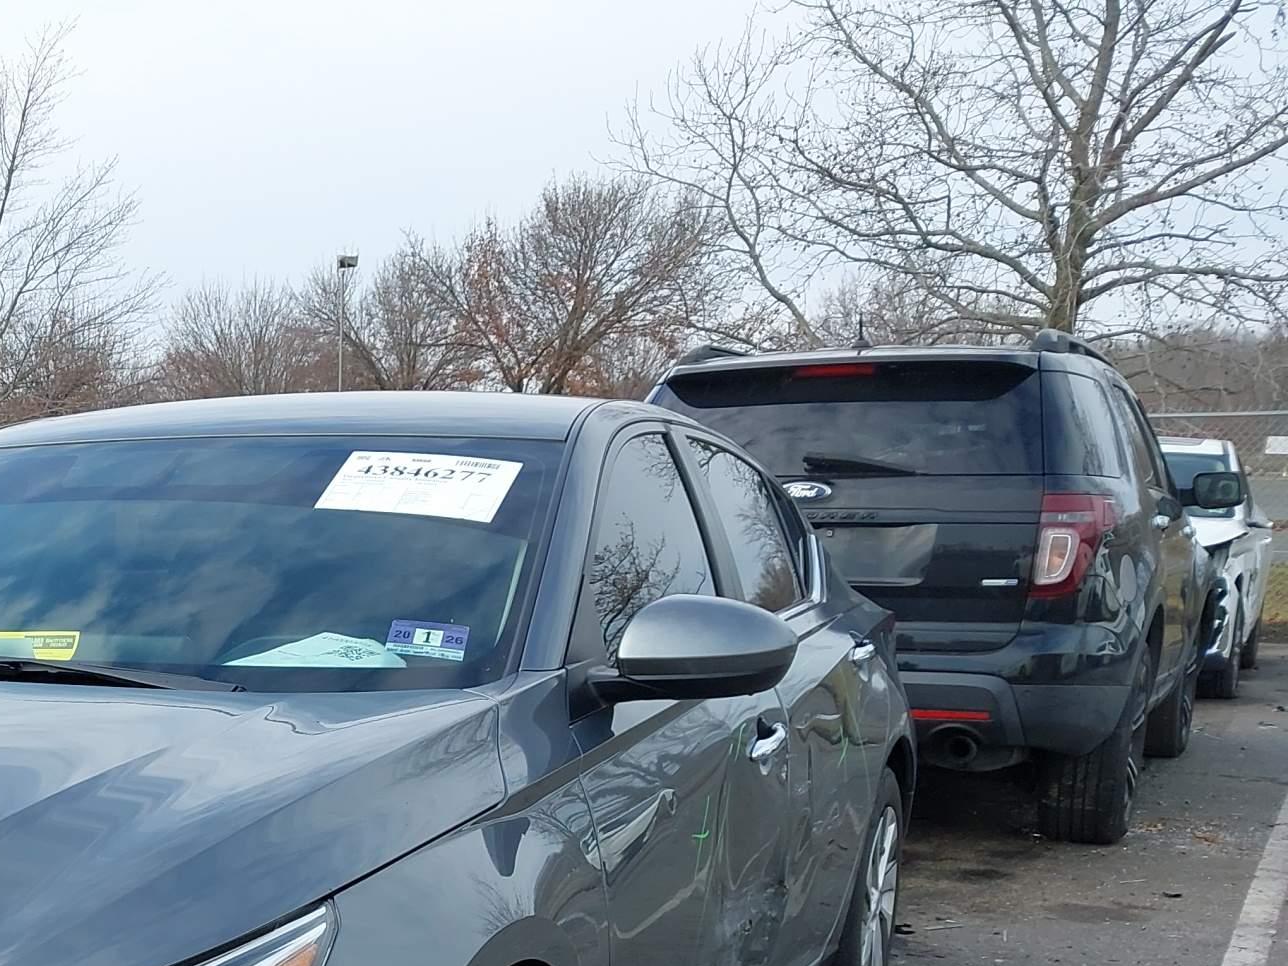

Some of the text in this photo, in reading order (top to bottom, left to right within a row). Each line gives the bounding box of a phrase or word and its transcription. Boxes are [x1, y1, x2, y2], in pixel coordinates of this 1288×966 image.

[357, 464, 492, 483] 43846277
[787, 484, 819, 498] Ford
[393, 629, 464, 645] 20 1 26
